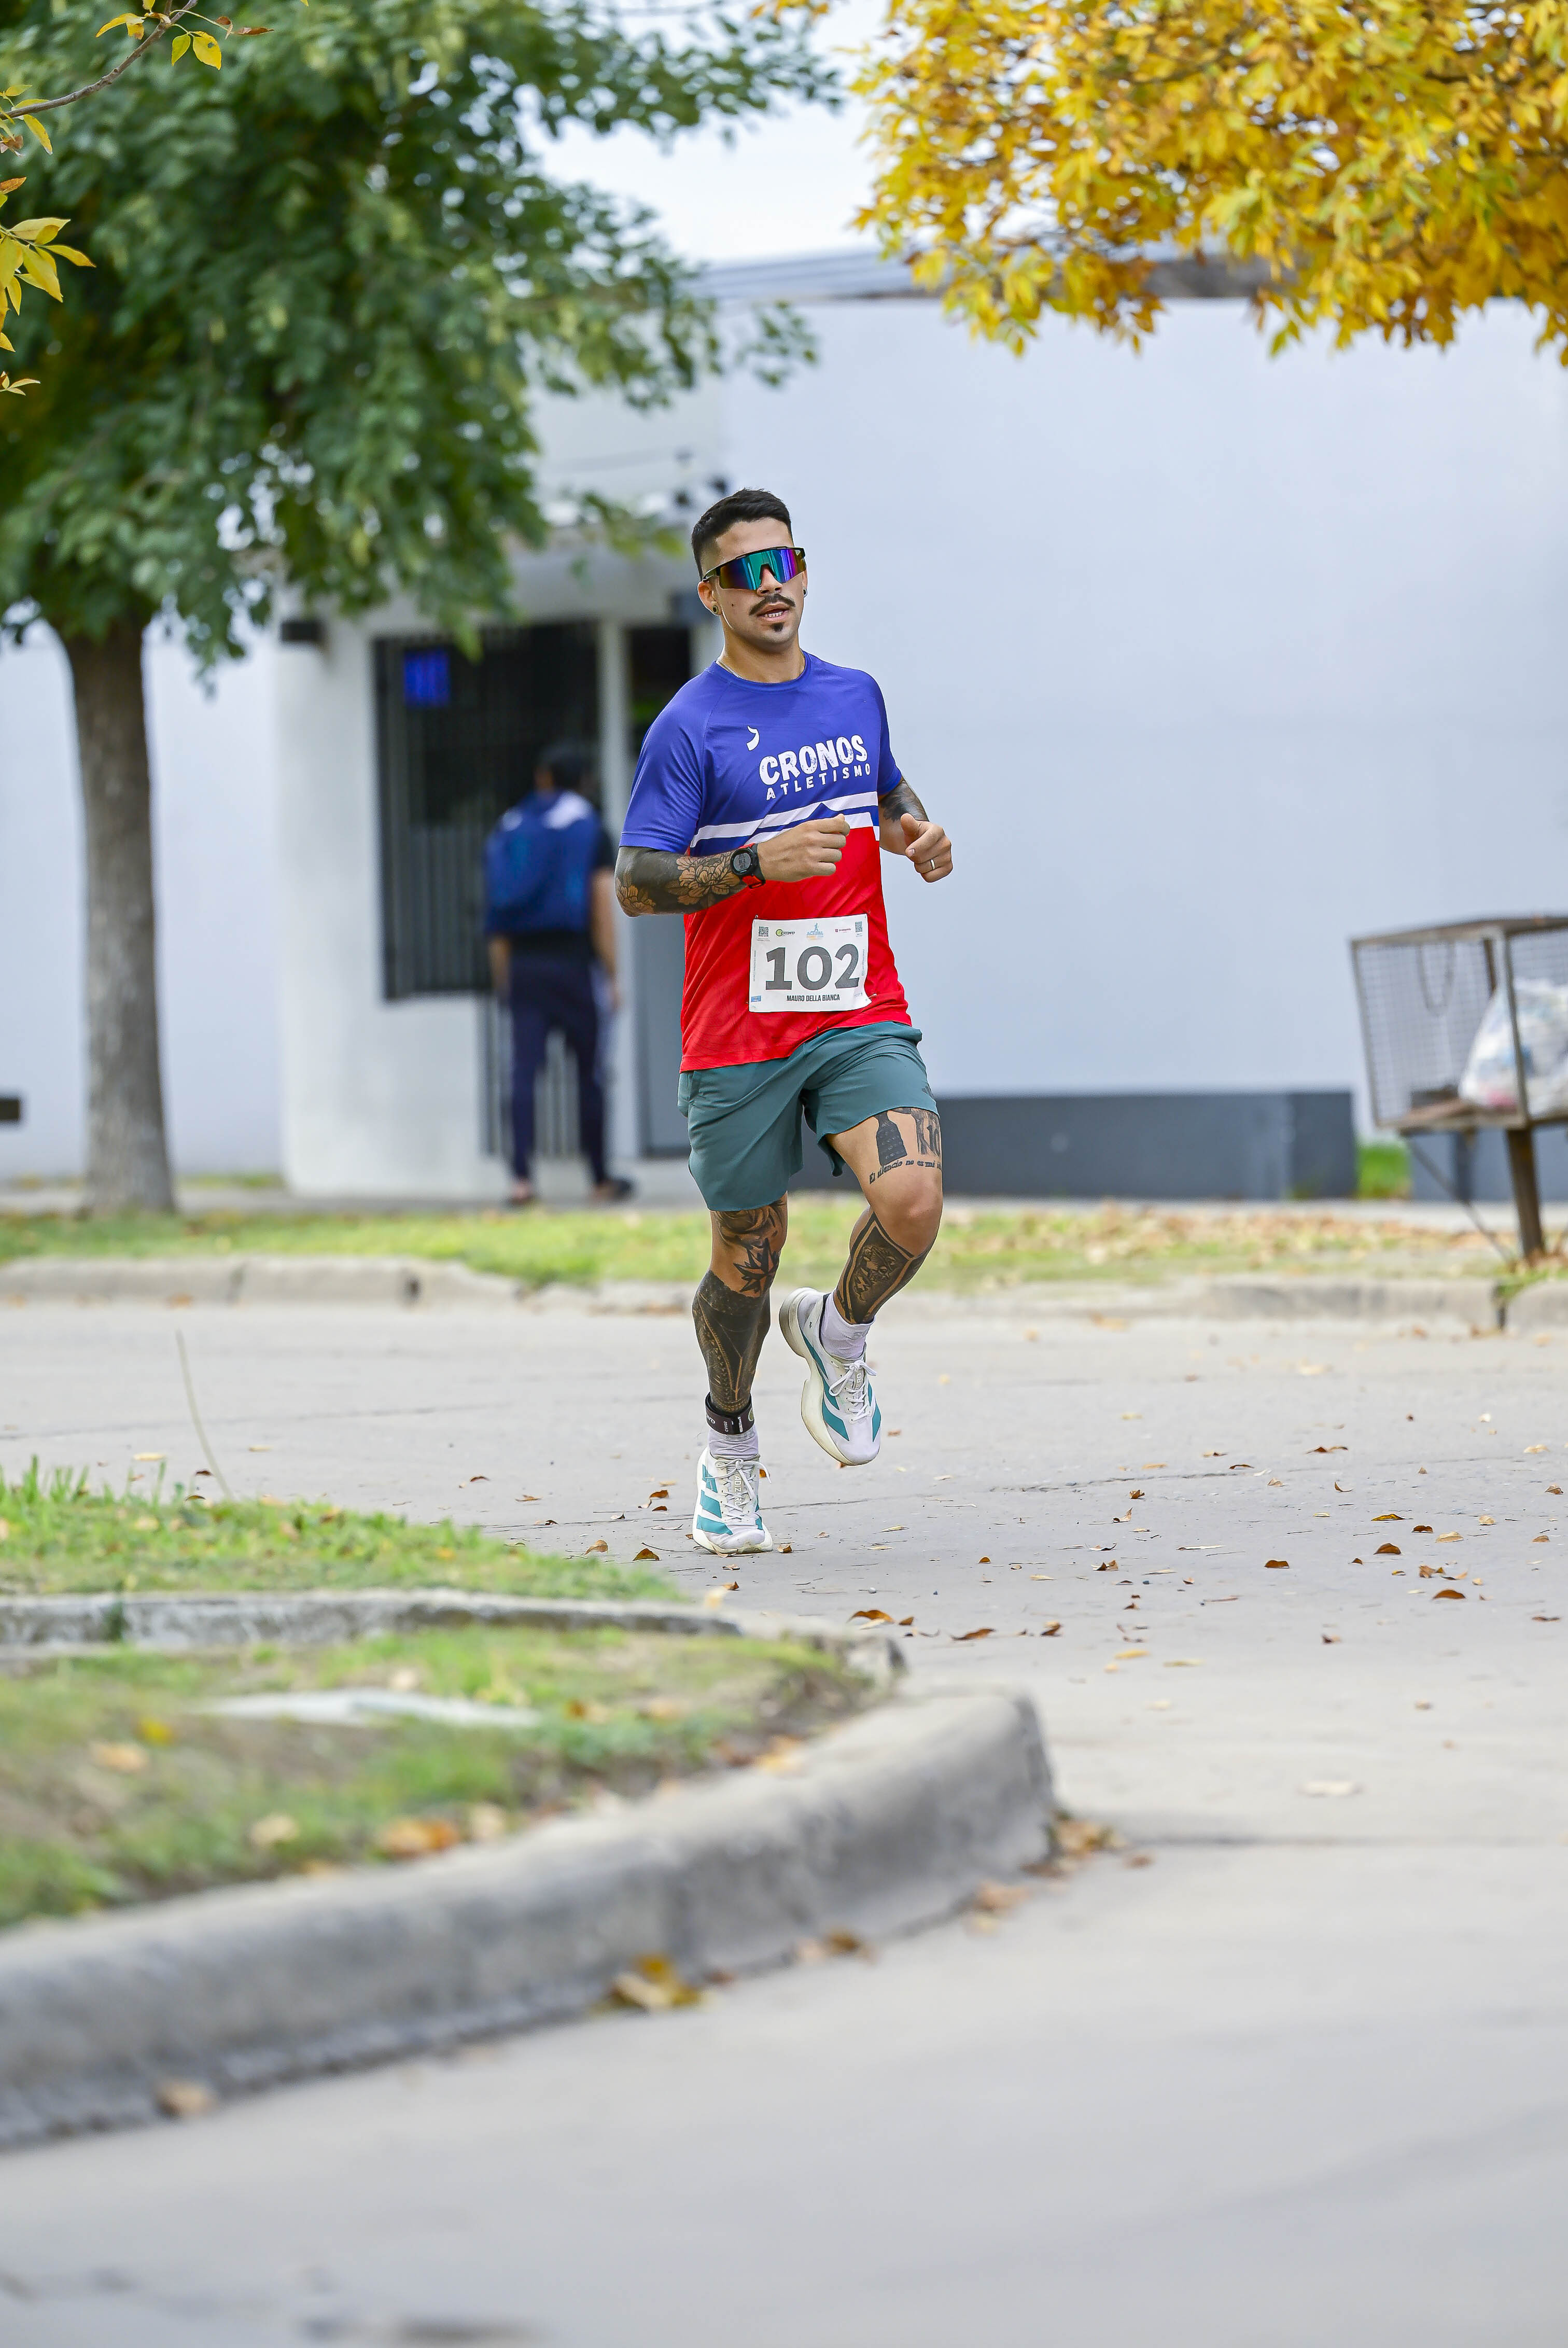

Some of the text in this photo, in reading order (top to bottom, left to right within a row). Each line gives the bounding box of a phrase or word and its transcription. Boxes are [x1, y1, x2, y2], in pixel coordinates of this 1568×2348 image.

[759, 735, 867, 785] CRONOS
[766, 763, 871, 801] ATLETISMO
[765, 944, 860, 990] 102
[734, 1475, 742, 1506] ADIZRO
